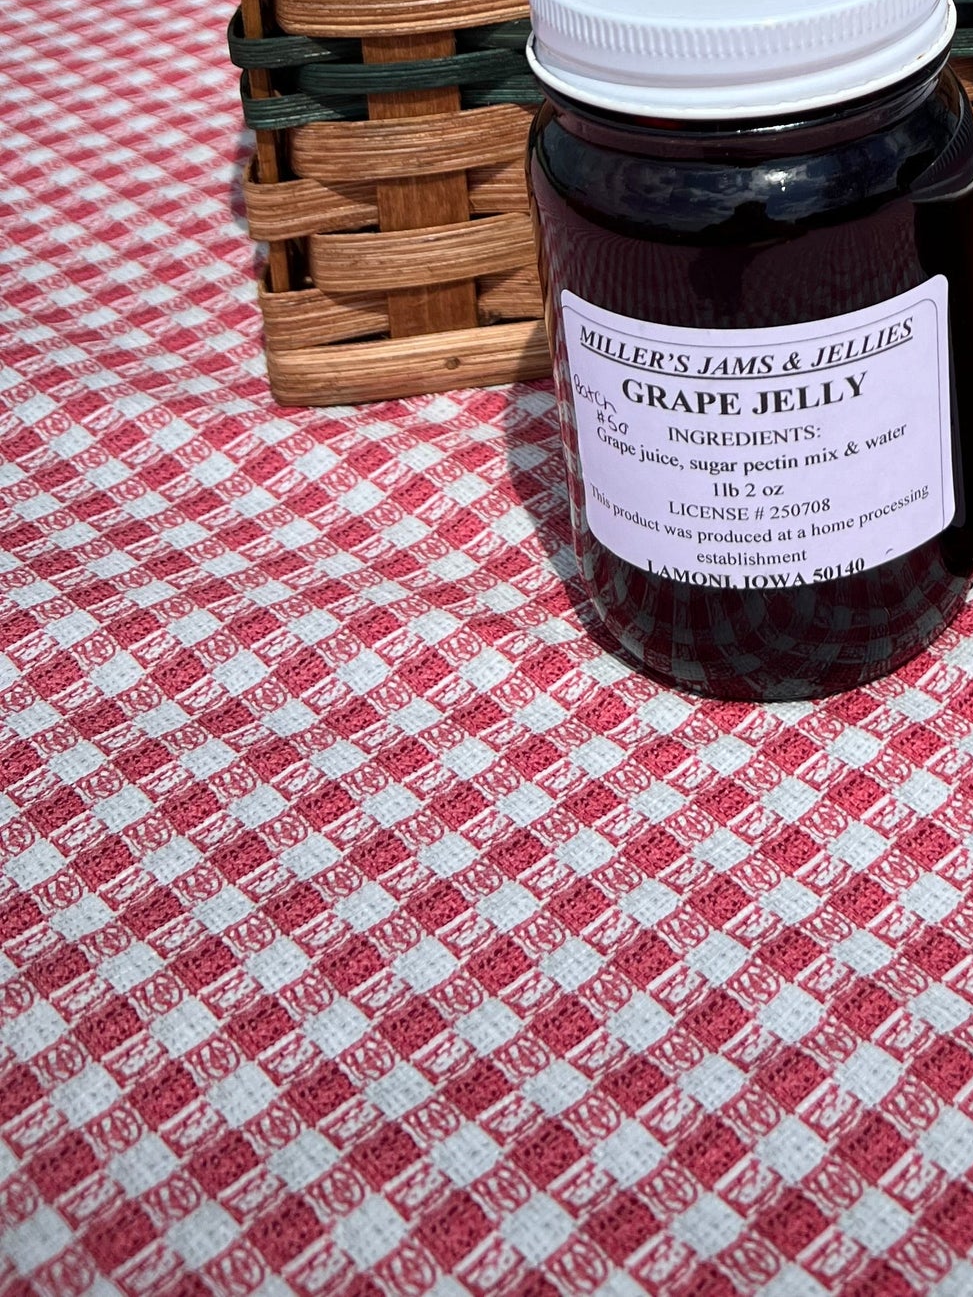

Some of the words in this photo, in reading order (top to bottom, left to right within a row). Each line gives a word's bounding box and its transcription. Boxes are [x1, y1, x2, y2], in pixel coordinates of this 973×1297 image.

[580, 325, 690, 374] MILLER'S
[697, 355, 774, 376] JAMS
[782, 351, 802, 372] &
[811, 316, 914, 368] JELLIES
[622, 377, 742, 416] GRAPE
[752, 370, 868, 415] JELLY
[597, 426, 636, 455] Grape
[639, 444, 684, 471] juice,
[689, 459, 738, 476] sugar
[743, 454, 799, 476] pectin
[804, 447, 839, 467] mix
[844, 440, 860, 457] &
[865, 423, 907, 450] water
[668, 424, 821, 447] INGREDIENTS:
[713, 482, 739, 498] 1lb
[745, 483, 756, 498] 2
[762, 484, 785, 497] oz
[590, 483, 611, 510] This
[613, 503, 660, 533] product
[664, 524, 693, 540] was
[697, 529, 772, 544] produced
[777, 527, 793, 542] at
[797, 528, 807, 539] a
[811, 517, 855, 537] home
[858, 484, 930, 528] processing
[668, 501, 749, 521] LICENSE
[755, 506, 765, 521] #
[770, 498, 831, 520] 250708
[646, 559, 738, 590] LAMONI,
[744, 572, 807, 589] IOWA
[812, 557, 865, 582] 50140
[696, 549, 808, 566] establishment
